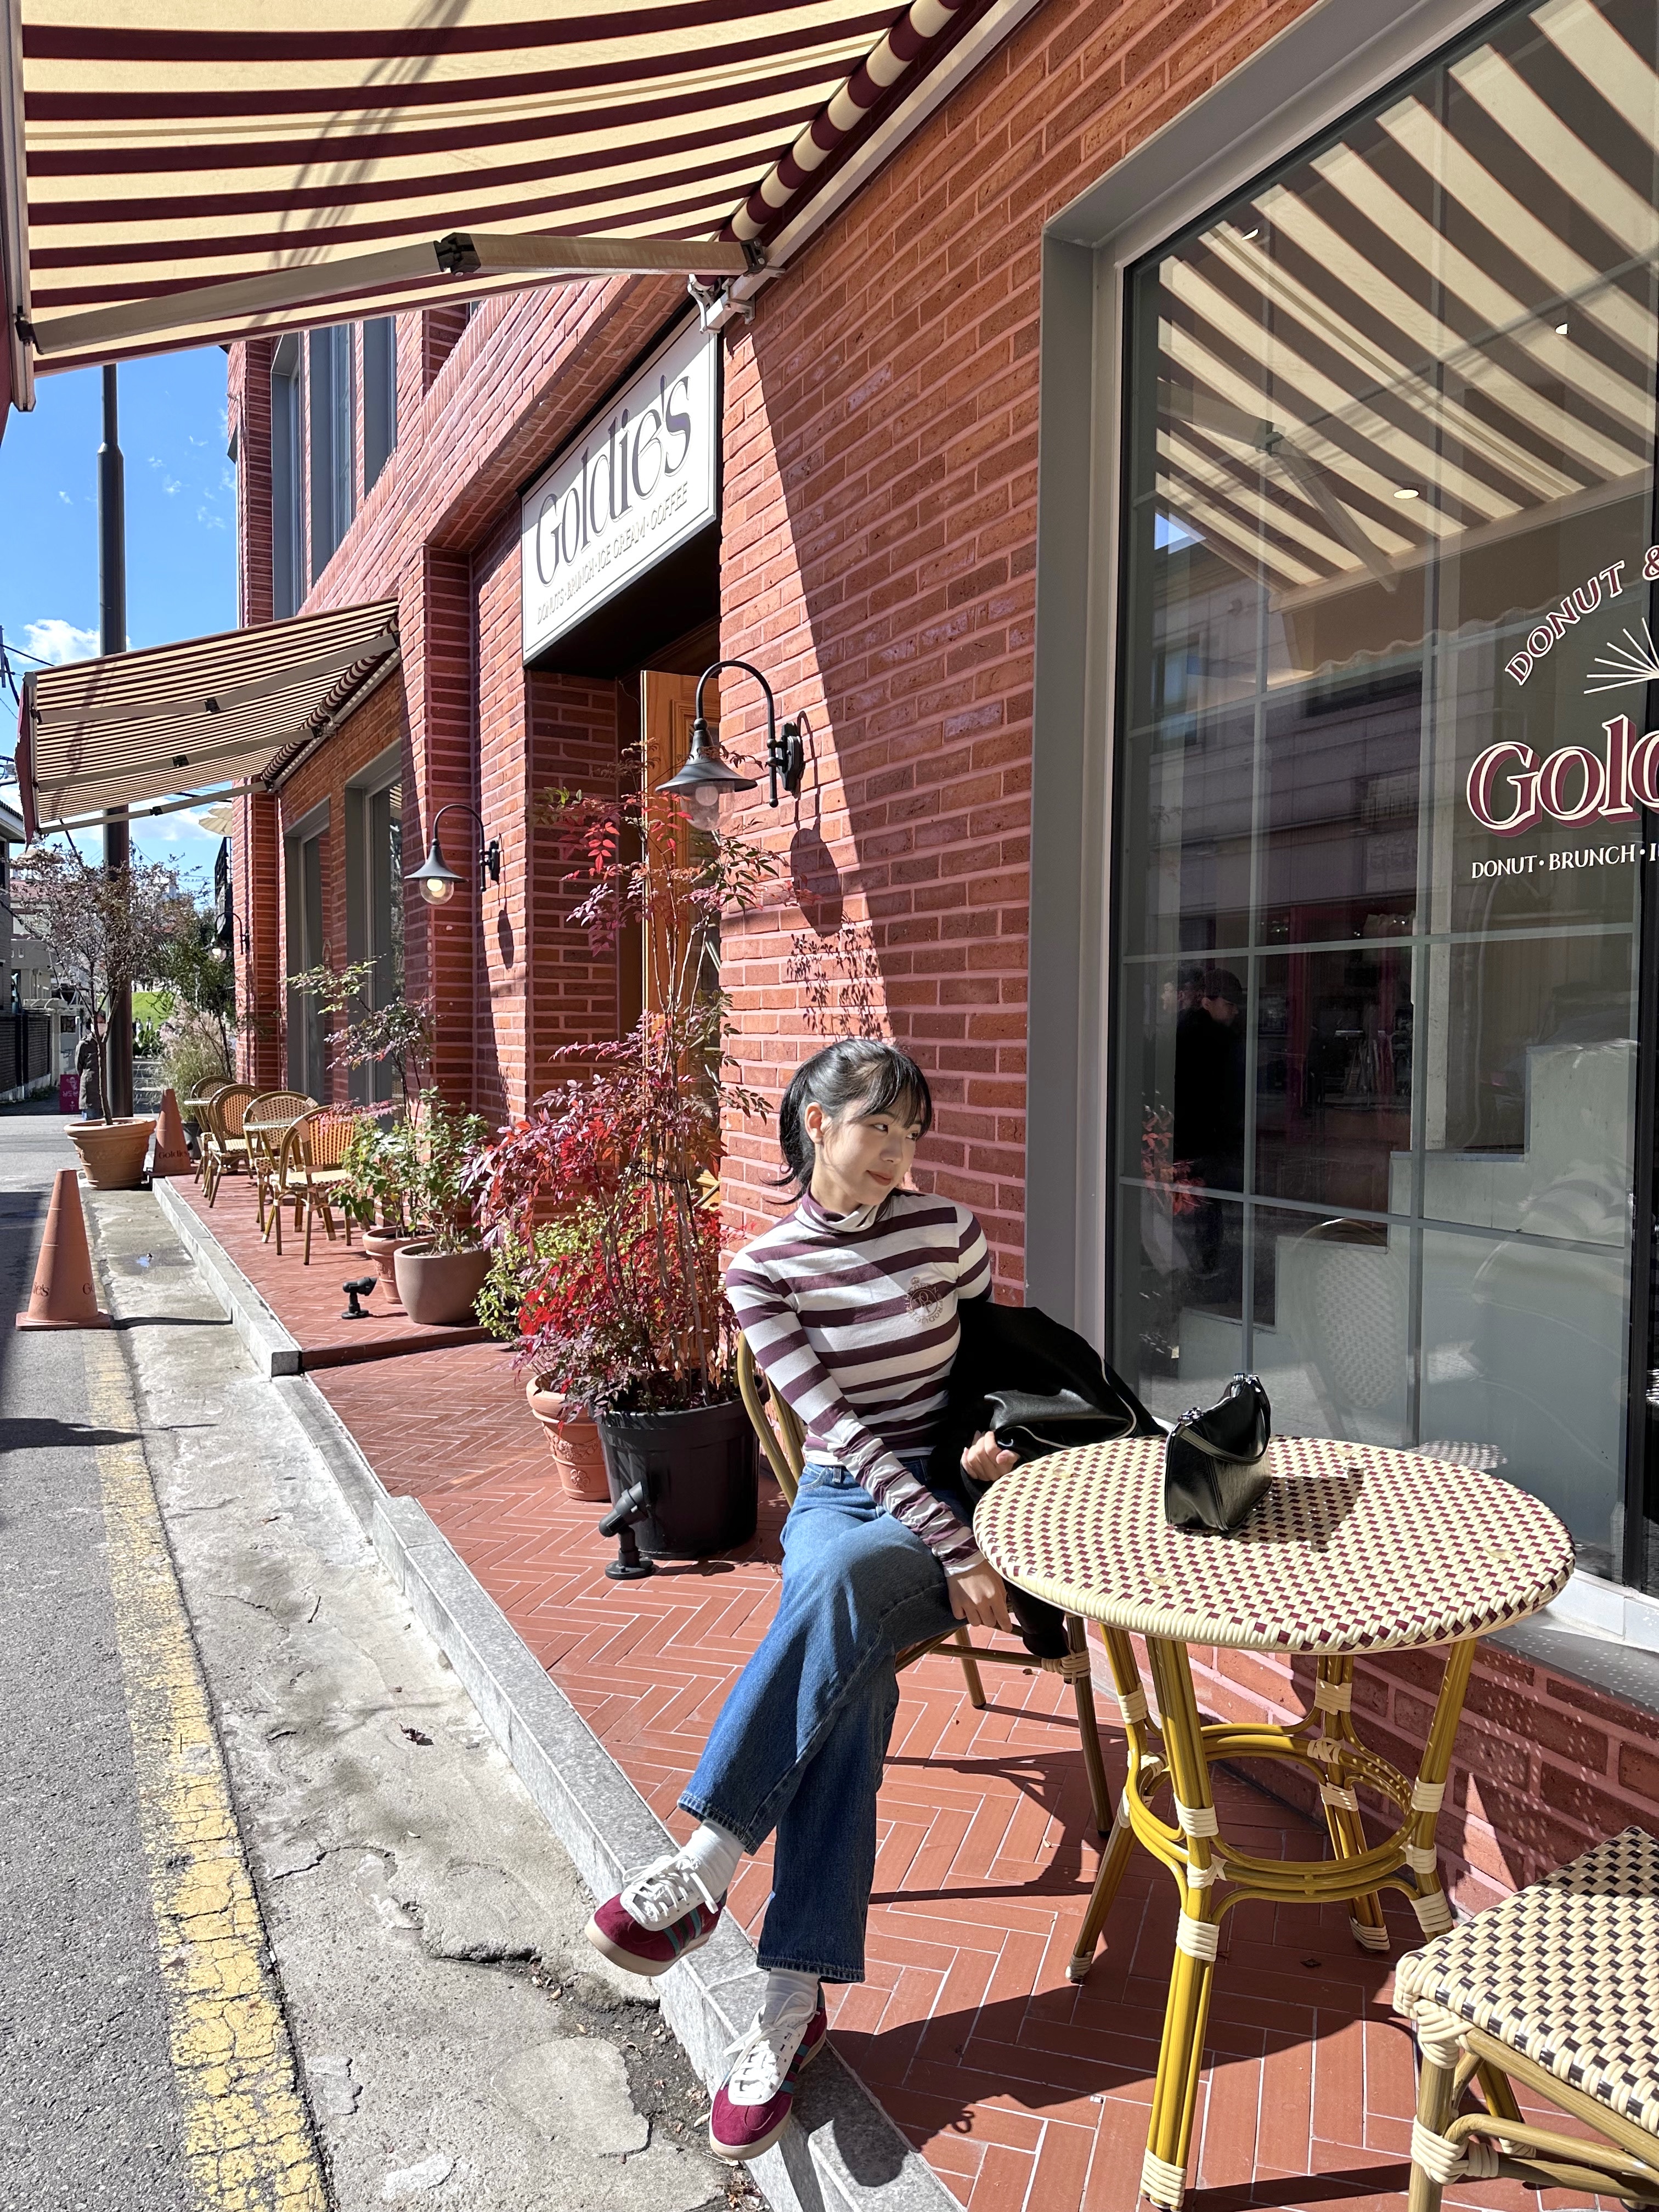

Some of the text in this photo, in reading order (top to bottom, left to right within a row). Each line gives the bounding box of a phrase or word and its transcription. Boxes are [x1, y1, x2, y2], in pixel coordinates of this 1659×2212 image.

[535, 374, 692, 588] Goldie's
[538, 481, 688, 625] DONUTS BRUNCH ICE CREAM COFFEE
[1504, 560, 1625, 686] DONUT
[1471, 854, 1538, 879] DONUT
[1549, 843, 1635, 871] BRUNCH
